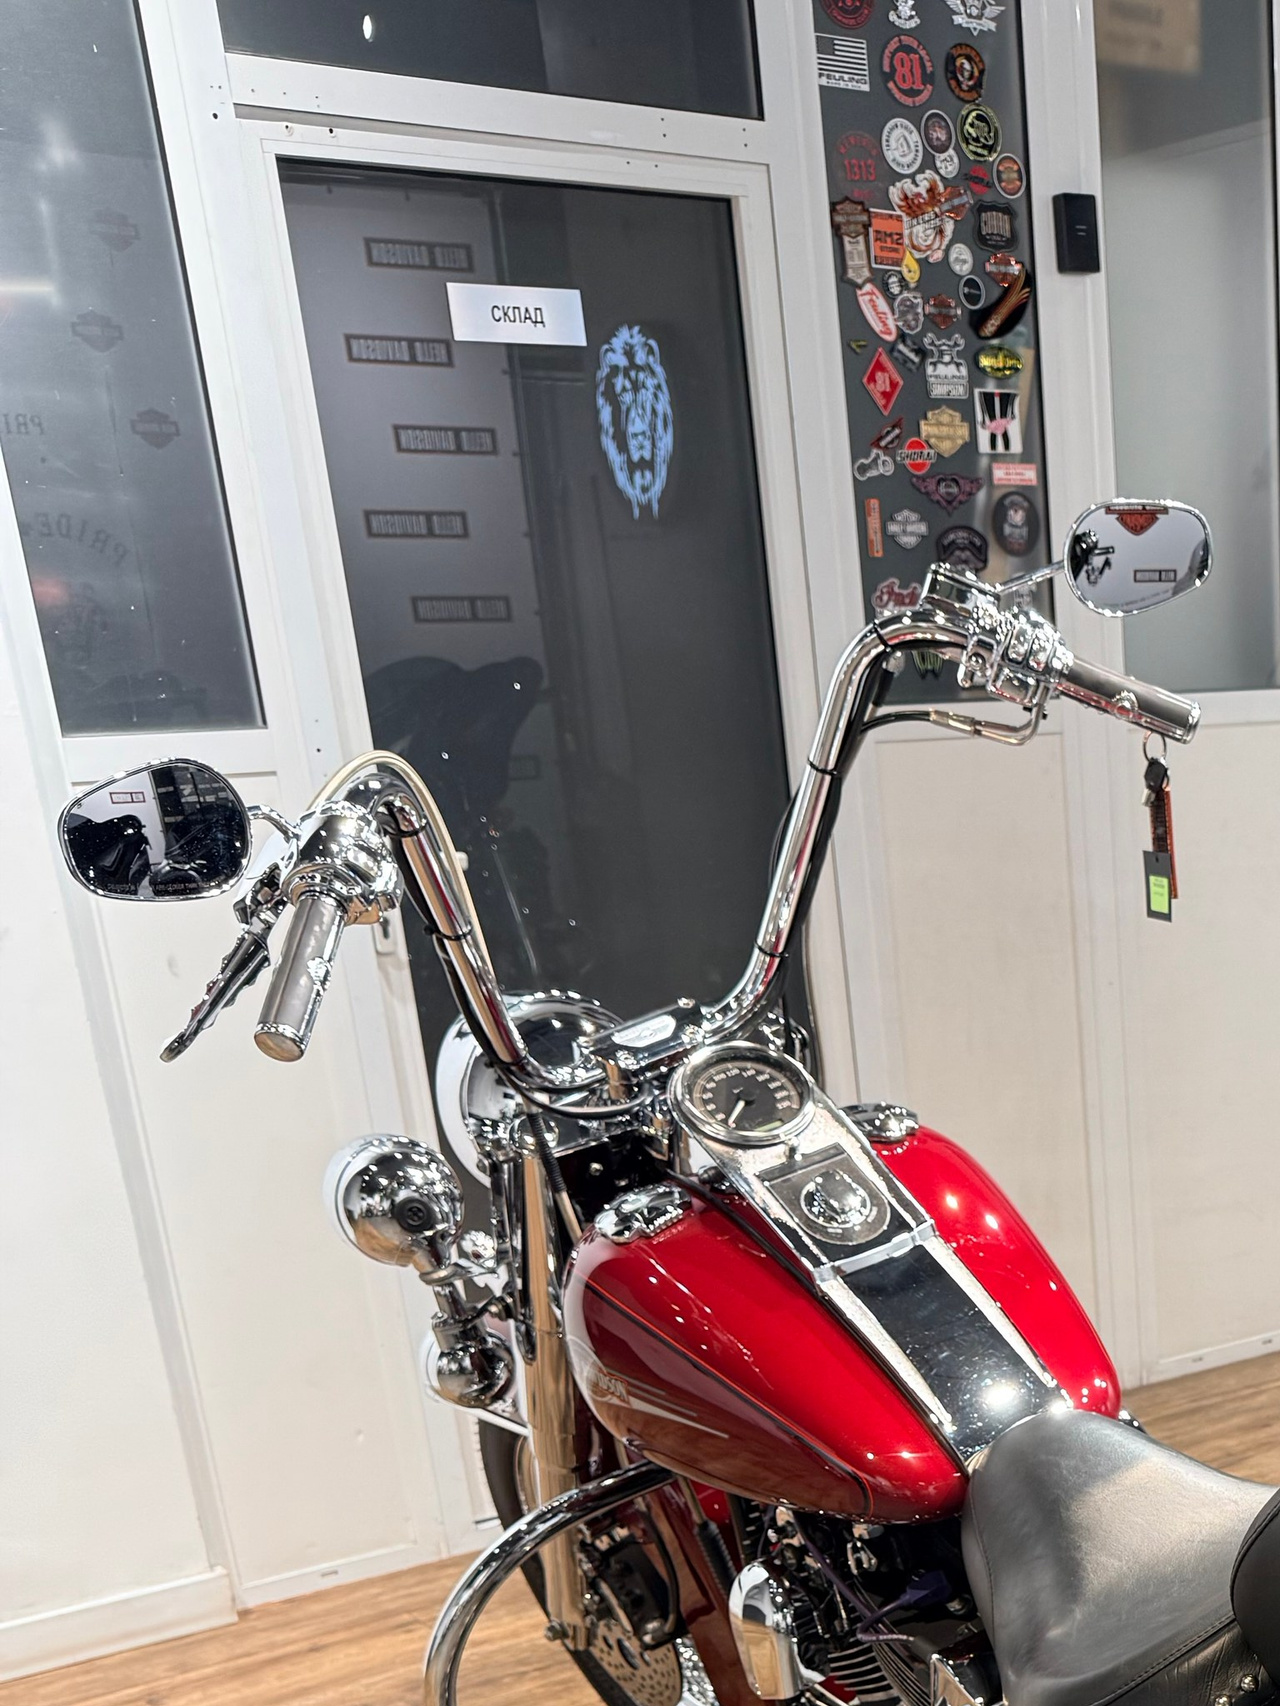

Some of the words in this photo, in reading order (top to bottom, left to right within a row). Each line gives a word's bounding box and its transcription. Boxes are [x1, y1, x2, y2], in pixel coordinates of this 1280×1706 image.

[818, 72, 868, 85] FEULING
[894, 52, 923, 90] 81
[844, 159, 877, 181] 1313
[490, 305, 546, 327] СКЛАД
